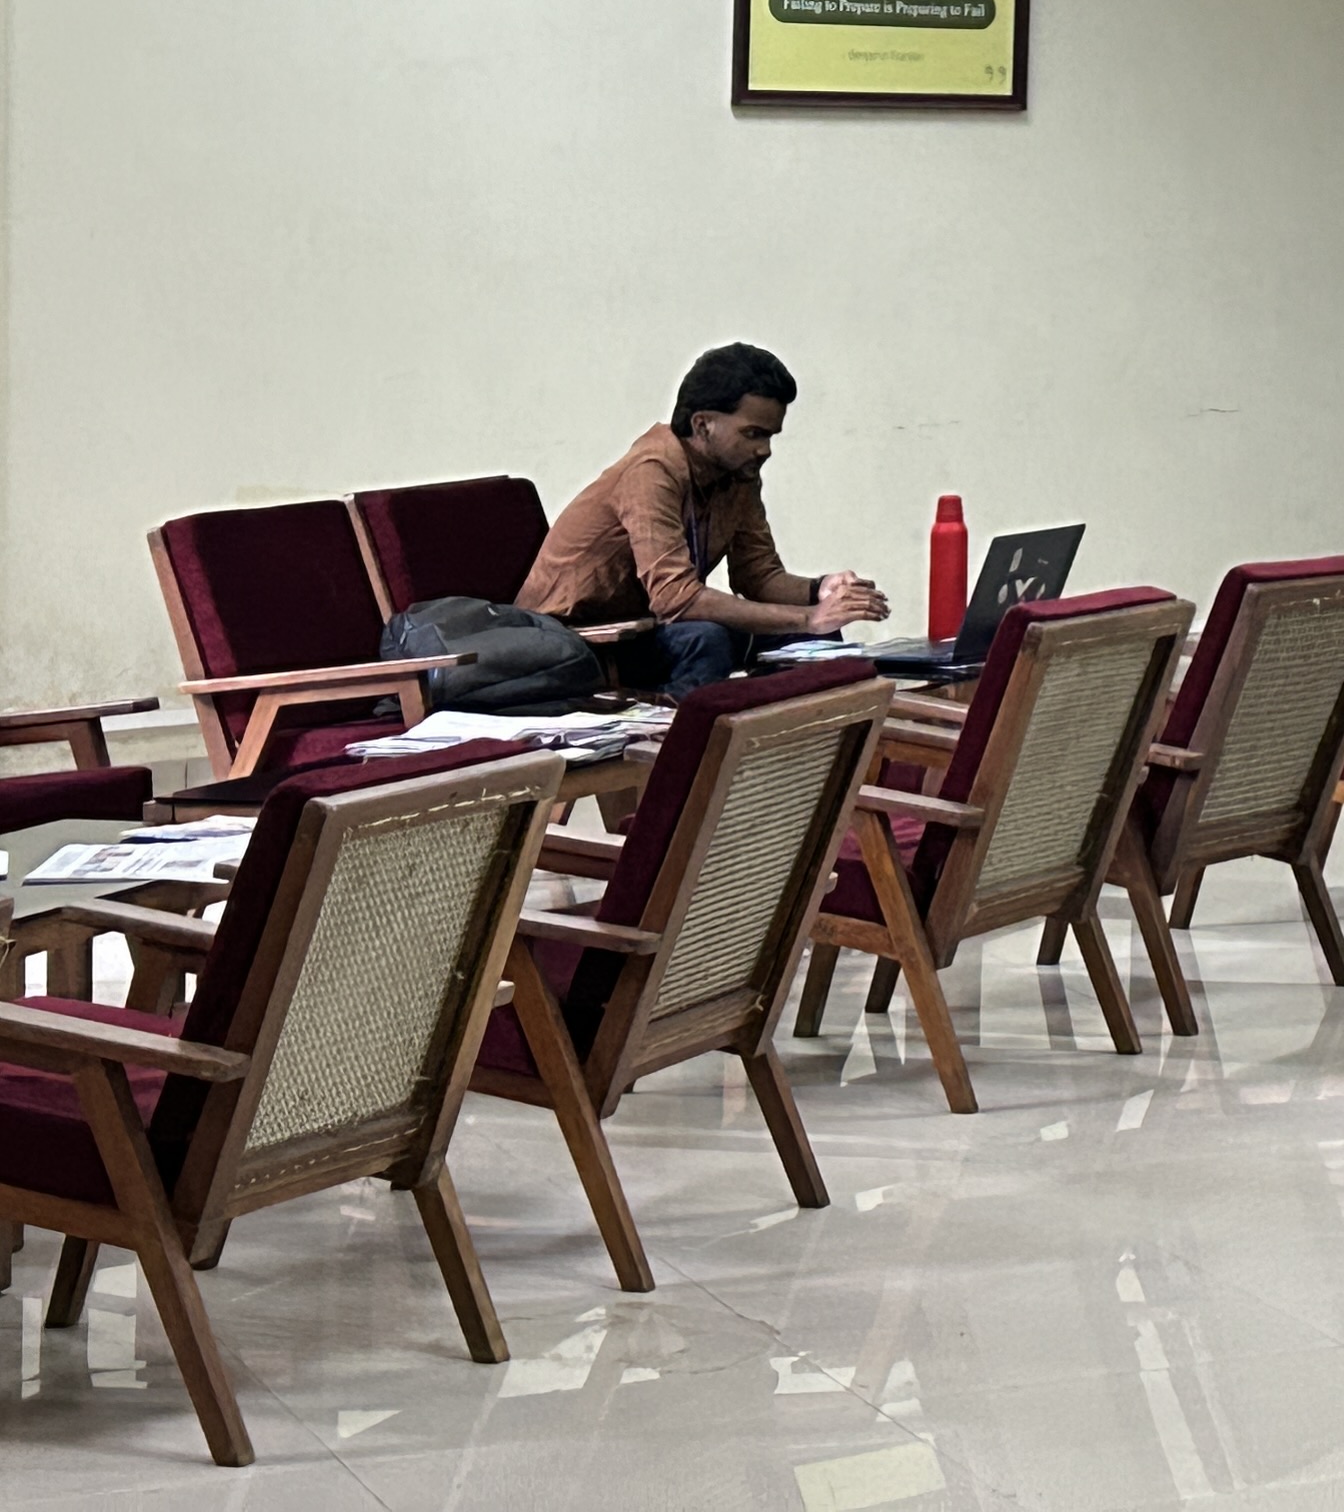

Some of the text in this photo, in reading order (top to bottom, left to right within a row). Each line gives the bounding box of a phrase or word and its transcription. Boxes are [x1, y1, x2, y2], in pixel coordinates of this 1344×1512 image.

[825, 0, 836, 11] to
[884, 0, 893, 13] is
[896, 0, 947, 18] Preparing
[950, 4, 961, 16] to
[964, 3, 985, 17] Fail
